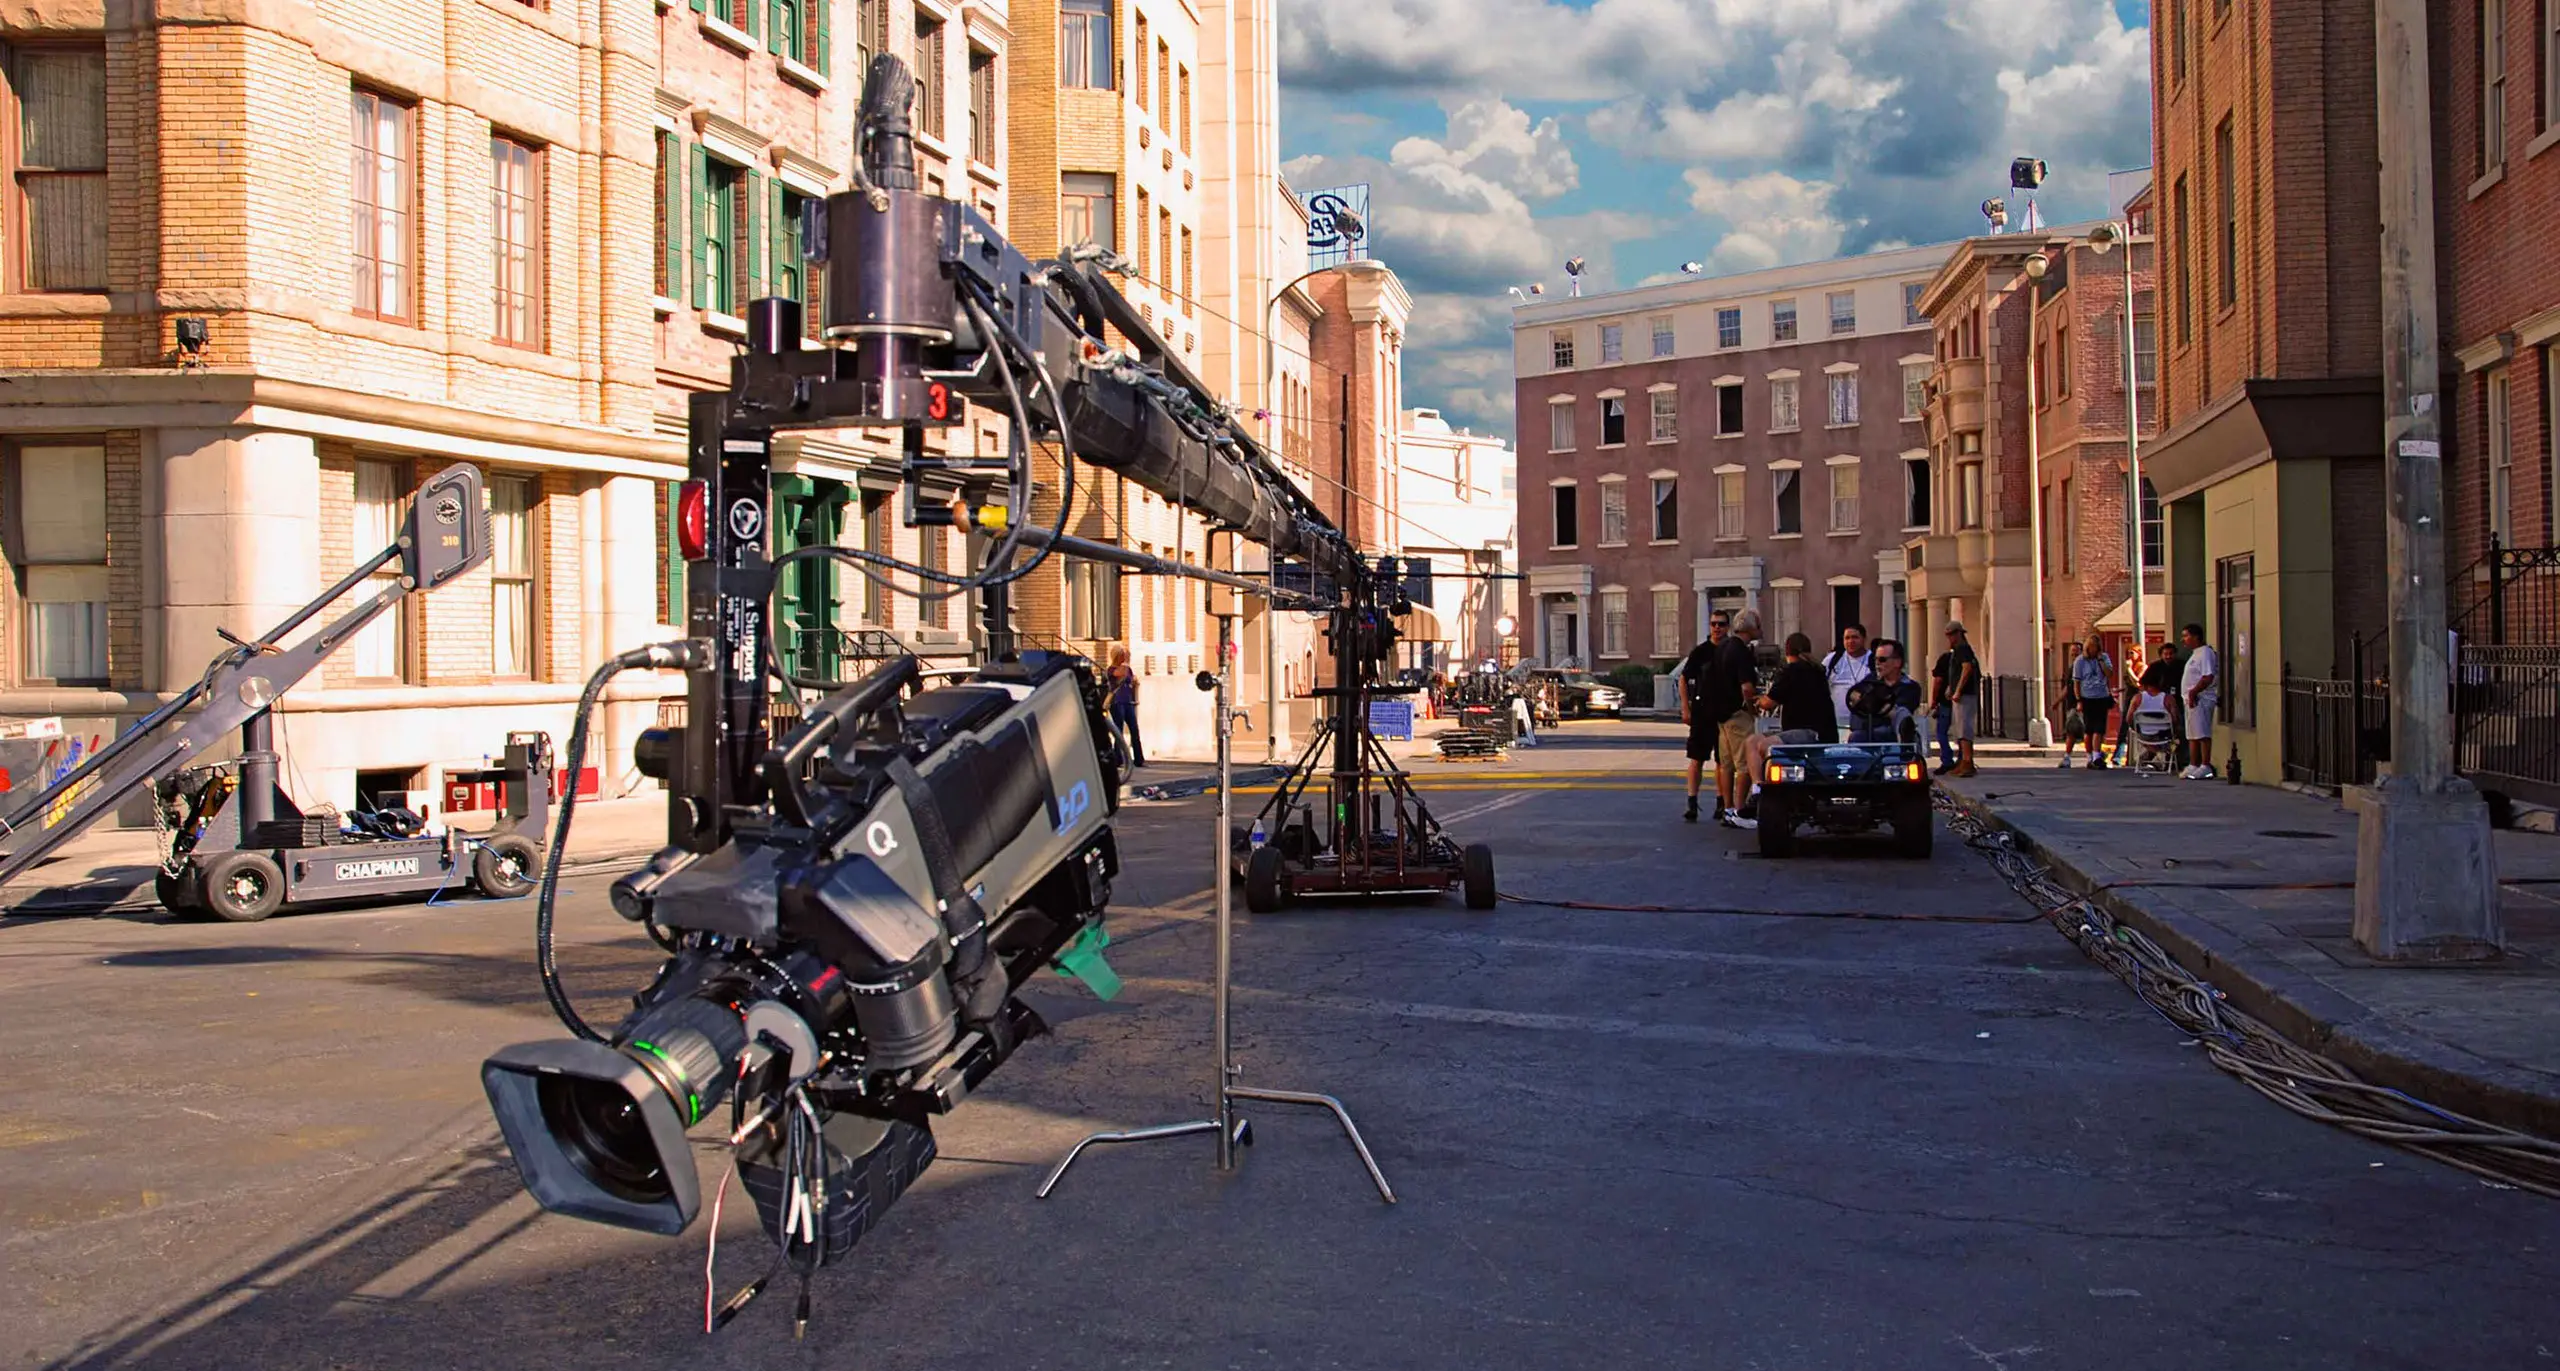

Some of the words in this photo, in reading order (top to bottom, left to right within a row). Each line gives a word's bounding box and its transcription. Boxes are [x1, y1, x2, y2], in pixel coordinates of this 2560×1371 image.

[929, 383, 947, 420] 3
[742, 612, 760, 682] Support
[866, 820, 899, 857] Q
[338, 859, 416, 879] CHAPMAN
